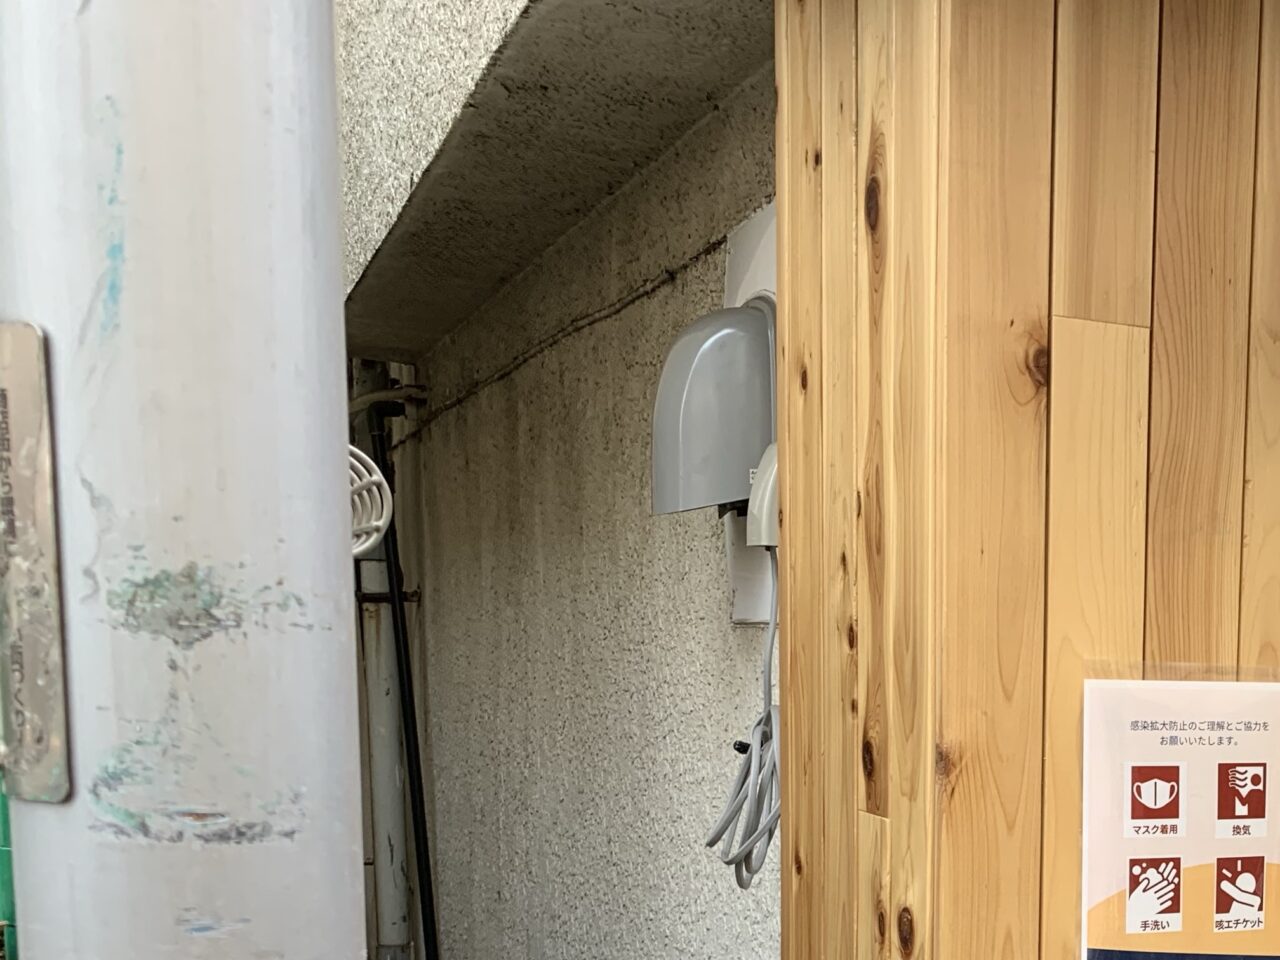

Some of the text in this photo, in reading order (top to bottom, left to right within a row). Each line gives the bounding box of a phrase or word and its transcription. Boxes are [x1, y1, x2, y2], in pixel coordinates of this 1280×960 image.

[1130, 720, 1270, 732] 感染拡大防止のご理解とご協力を
[1160, 735, 1238, 746] お願いいたします。
[1133, 824, 1178, 835] マスク着用
[1232, 824, 1251, 836] 換気
[1140, 920, 1170, 931] 手洗い
[1215, 917, 1263, 930] 咳エチケット
